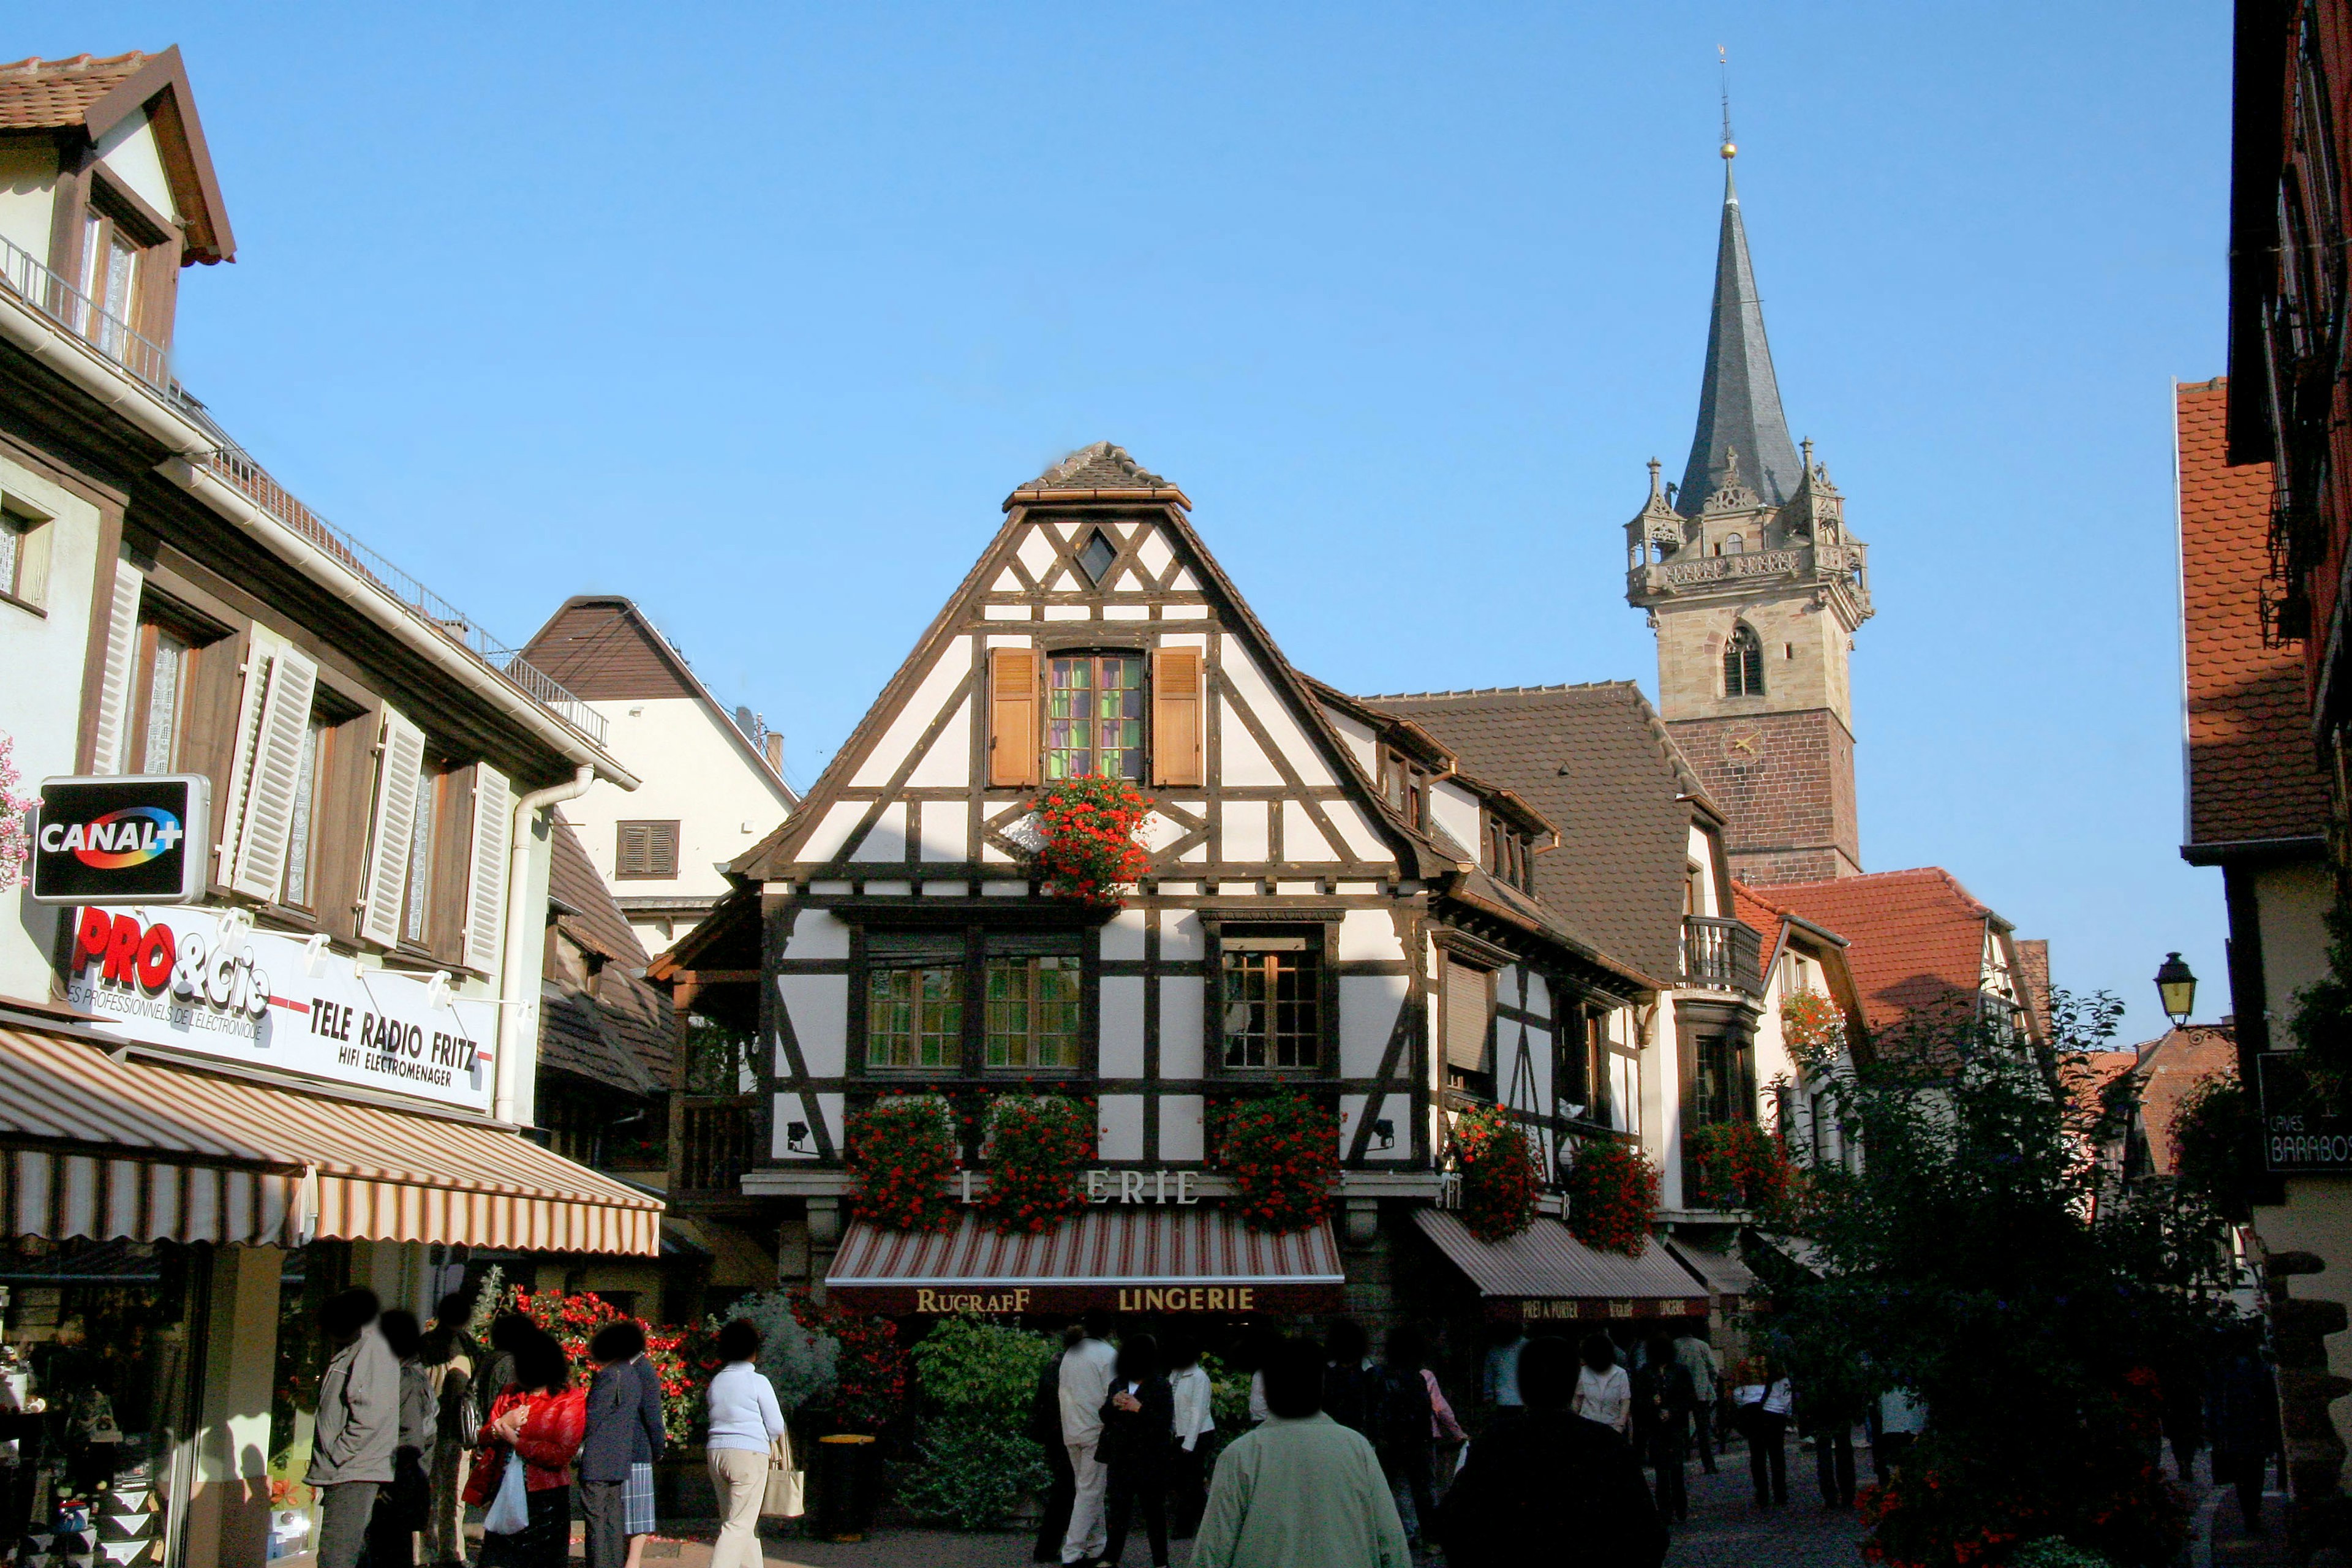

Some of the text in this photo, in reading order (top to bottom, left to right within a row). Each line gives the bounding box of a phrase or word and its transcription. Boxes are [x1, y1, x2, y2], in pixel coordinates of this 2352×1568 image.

[40, 821, 183, 852] CANAL+
[83, 989, 172, 1020] PROFESSIONNELS
[174, 1008, 188, 1025] DE
[311, 998, 477, 1072] TELE RADIO FRITZ
[339, 1046, 451, 1087] HIFI ELECTROMENAGER
[2269, 1115, 2305, 1133] CAVES
[1120, 1287, 1254, 1311] LINGERIE
